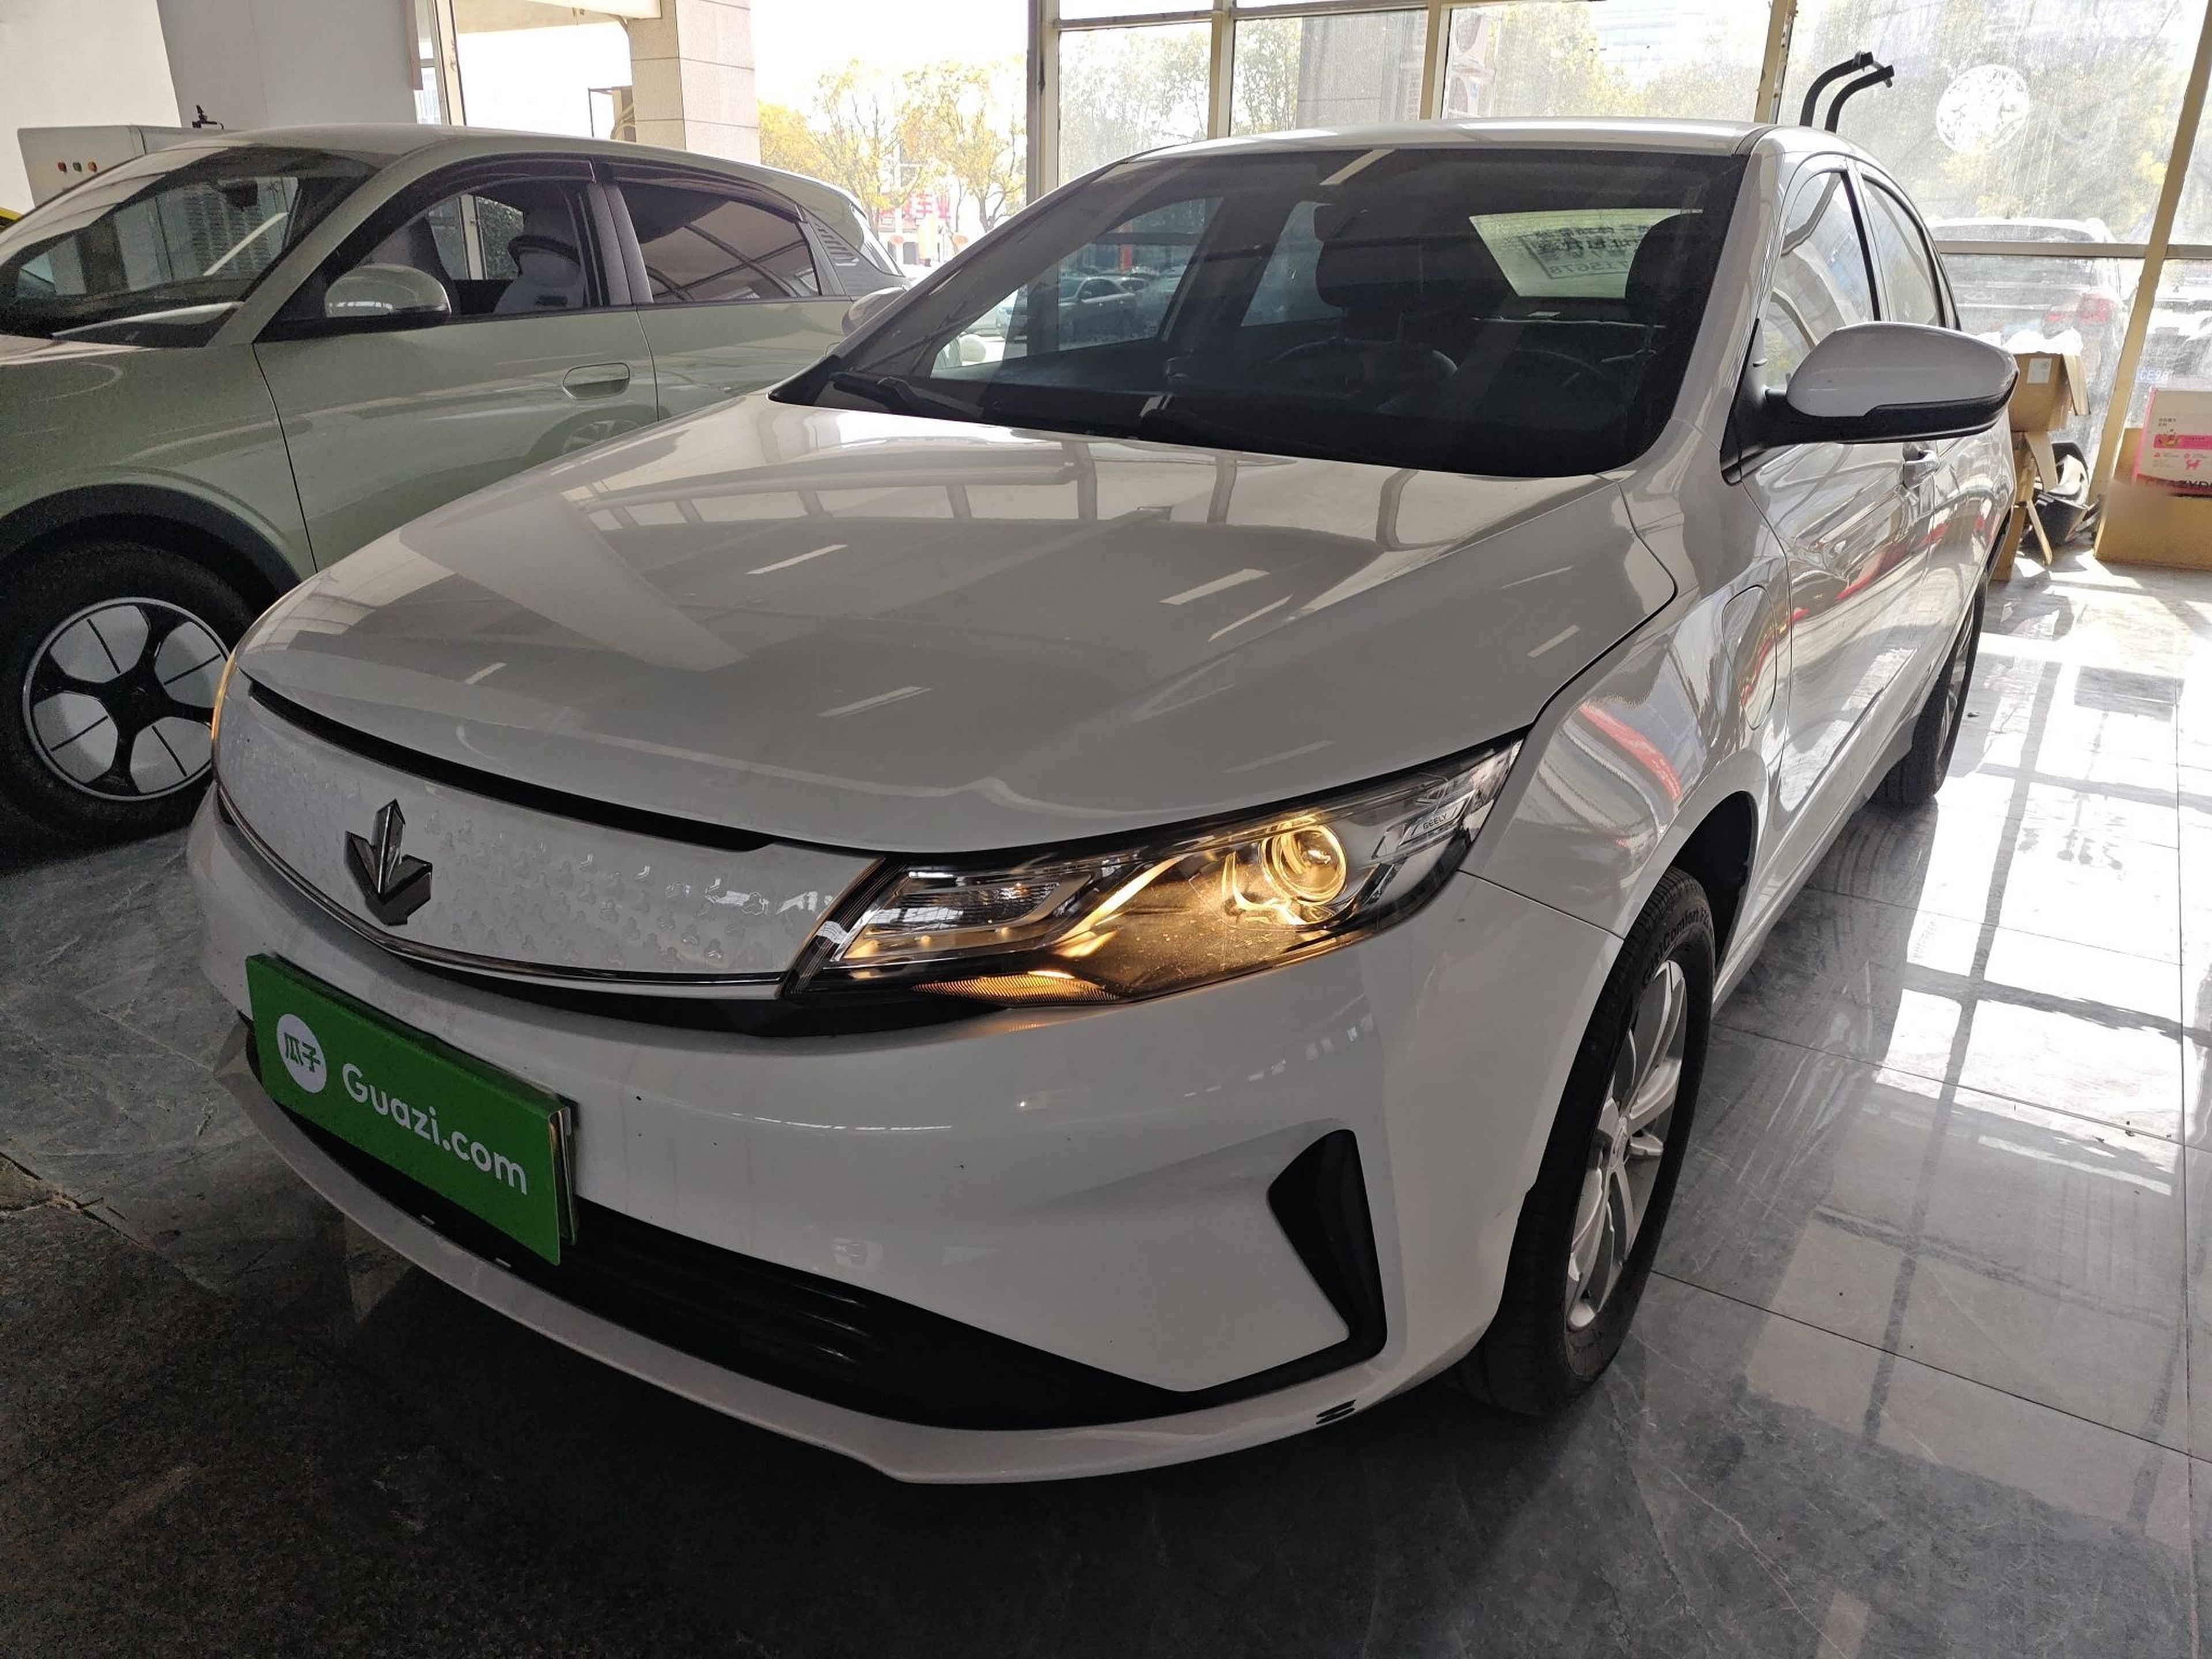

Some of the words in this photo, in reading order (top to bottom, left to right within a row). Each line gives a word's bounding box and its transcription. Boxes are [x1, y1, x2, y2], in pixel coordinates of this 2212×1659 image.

[1423, 813, 1446, 830] GEELY
[284, 1033, 320, 1073] 瓜子
[342, 1063, 527, 1195] Guazi.com
